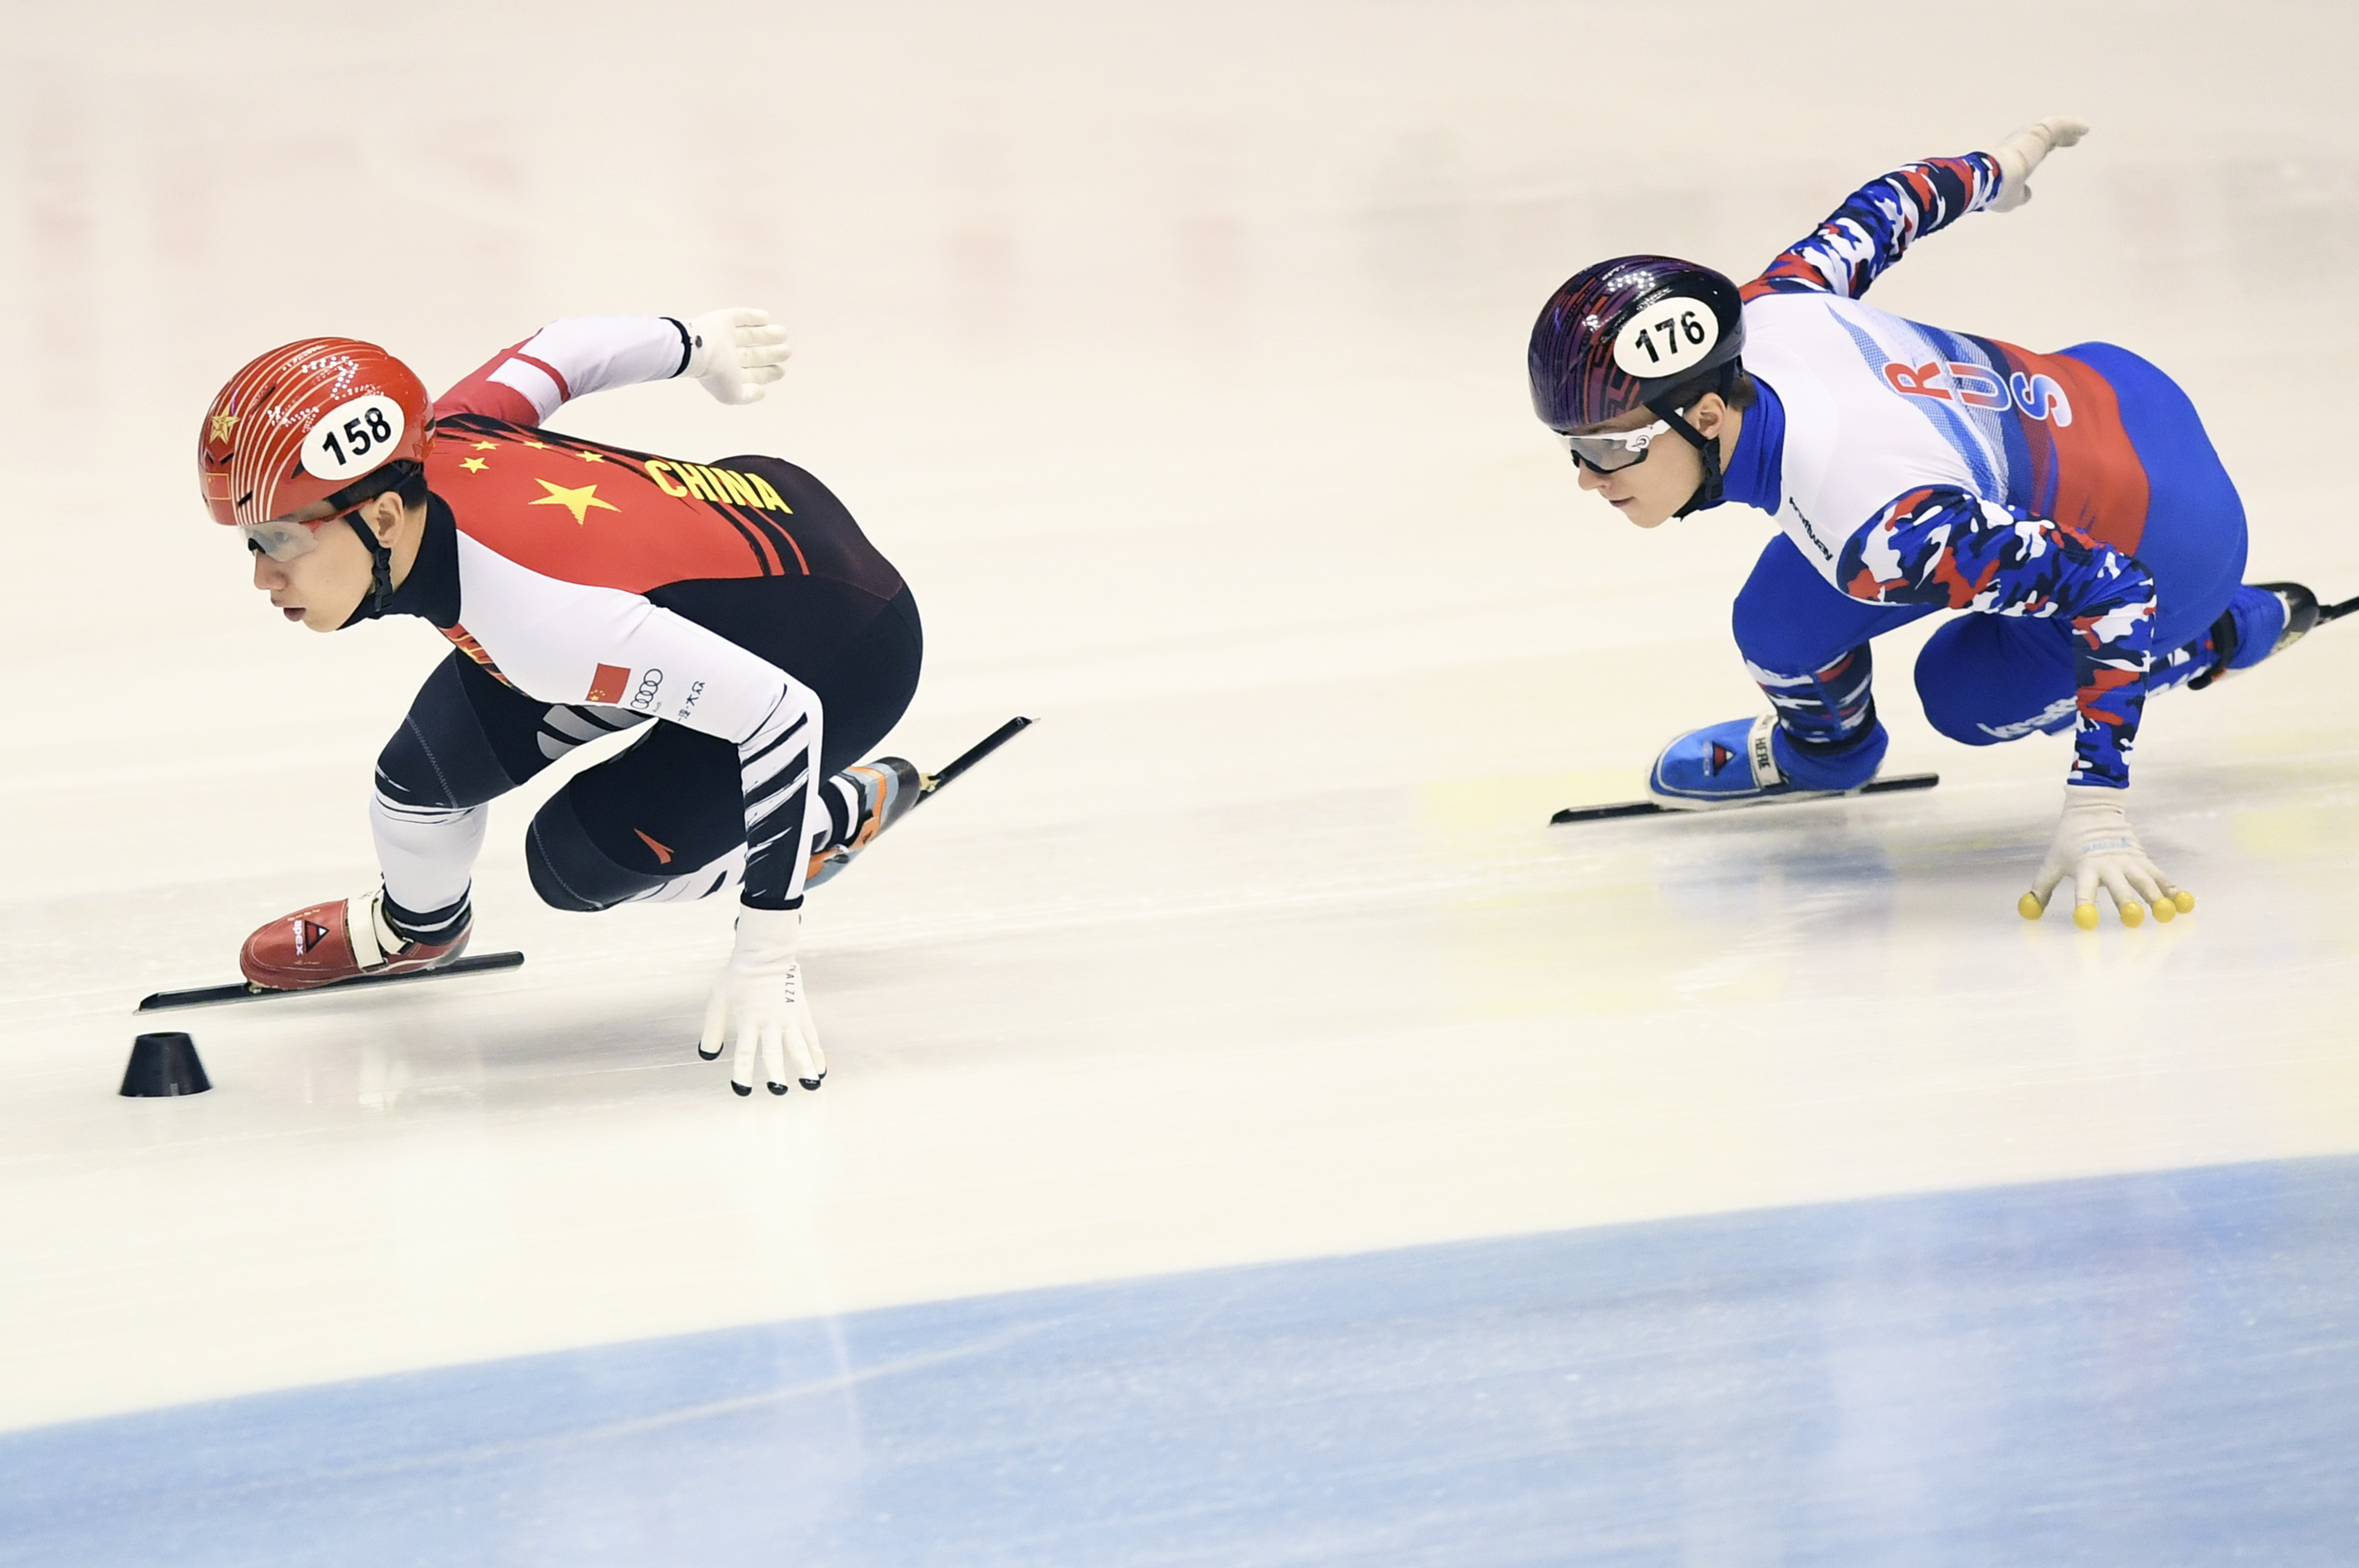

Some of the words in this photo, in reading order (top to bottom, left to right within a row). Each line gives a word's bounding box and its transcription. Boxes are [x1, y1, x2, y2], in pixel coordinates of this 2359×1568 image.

[1635, 311, 1705, 363] 176
[1883, 361, 2073, 428] RUS
[322, 406, 392, 466] 158
[644, 459, 794, 515] CHINA
[1755, 737, 1771, 771] HERE
